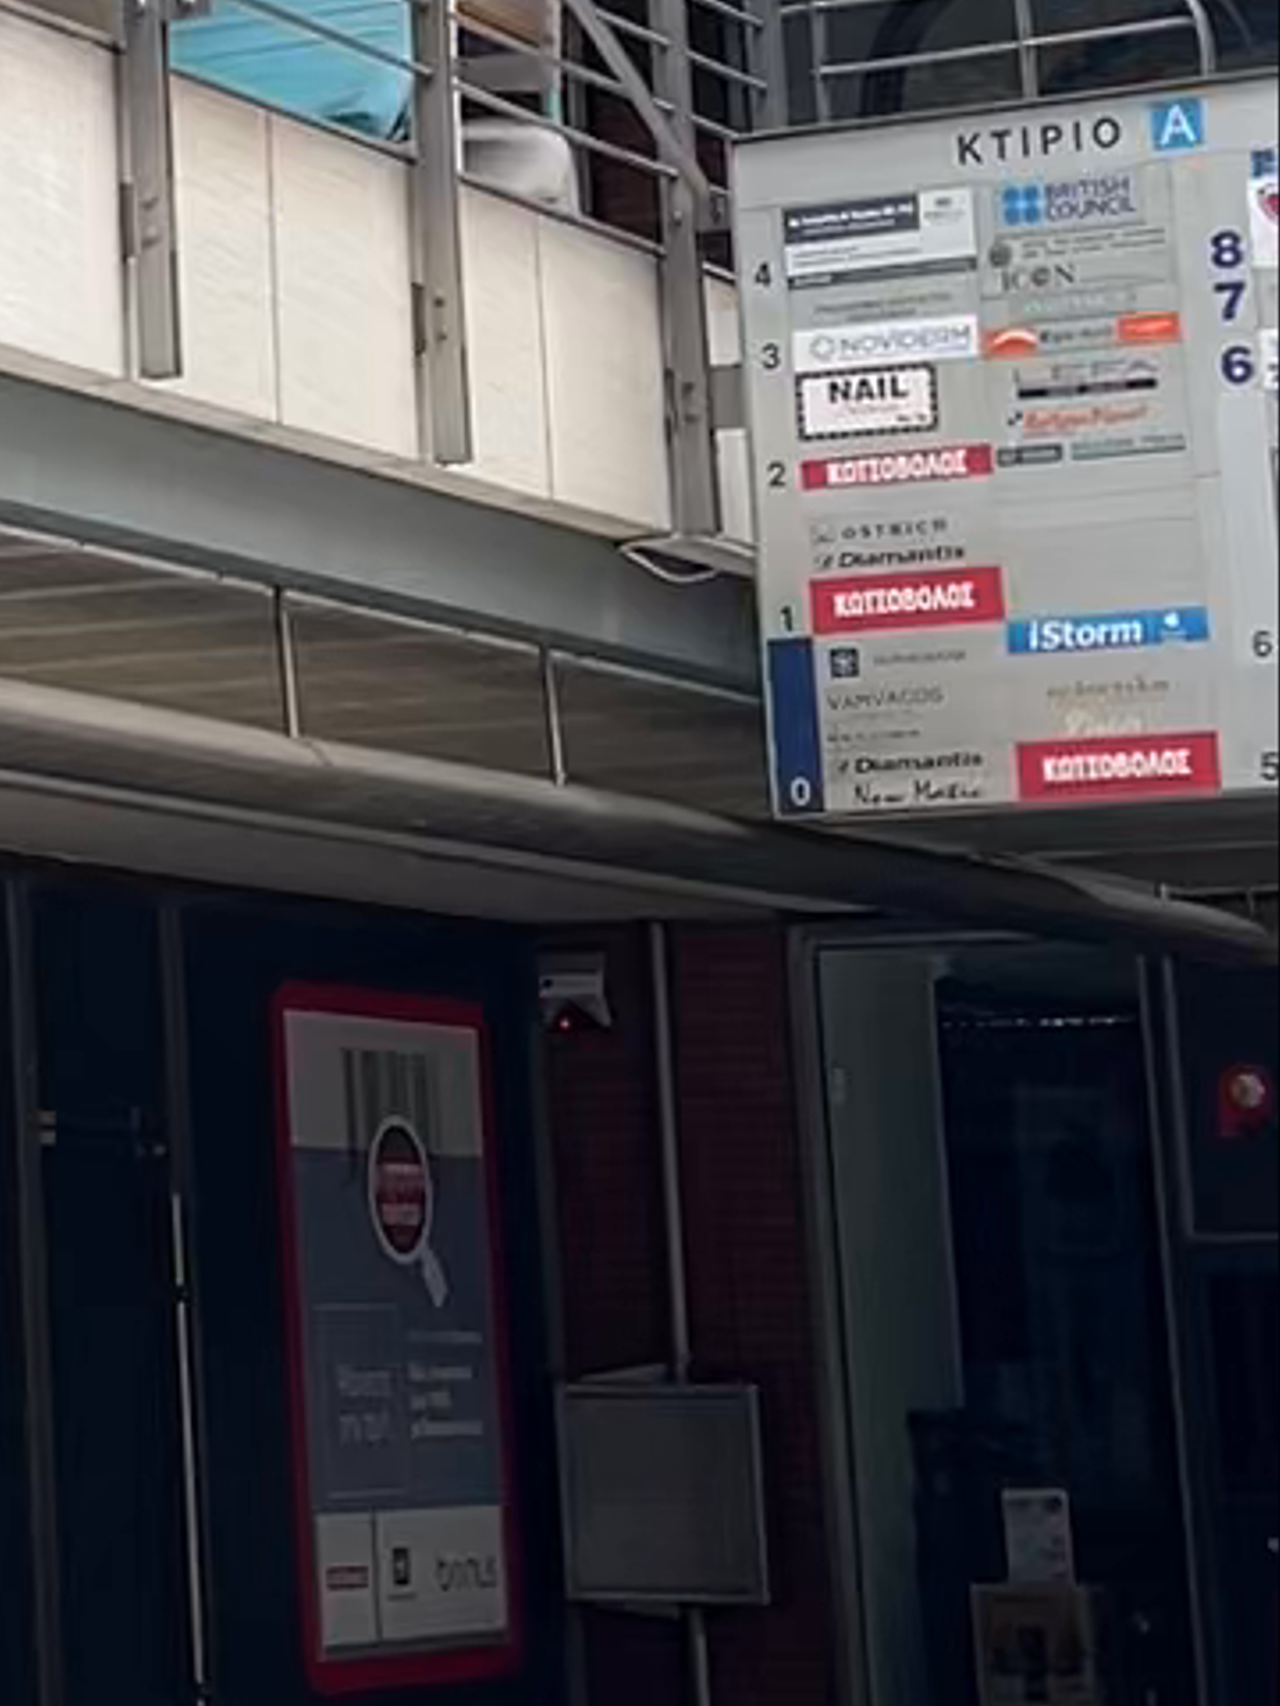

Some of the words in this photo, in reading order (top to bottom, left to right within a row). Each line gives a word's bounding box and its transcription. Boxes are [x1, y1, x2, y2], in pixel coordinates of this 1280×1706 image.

[1043, 176, 1131, 200] BRITISH
[1044, 198, 1138, 223] COUNCIL
[1210, 230, 1244, 269] 8
[754, 262, 772, 287] 4
[1212, 280, 1246, 322] 7
[761, 343, 781, 370] 3
[1220, 345, 1254, 385] 6
[828, 374, 910, 403] NAIL
[767, 461, 787, 487] 2
[779, 605, 794, 632] 1
[1027, 617, 1144, 651] iStorm
[1252, 628, 1275, 659] 6
[790, 775, 813, 807] 0
